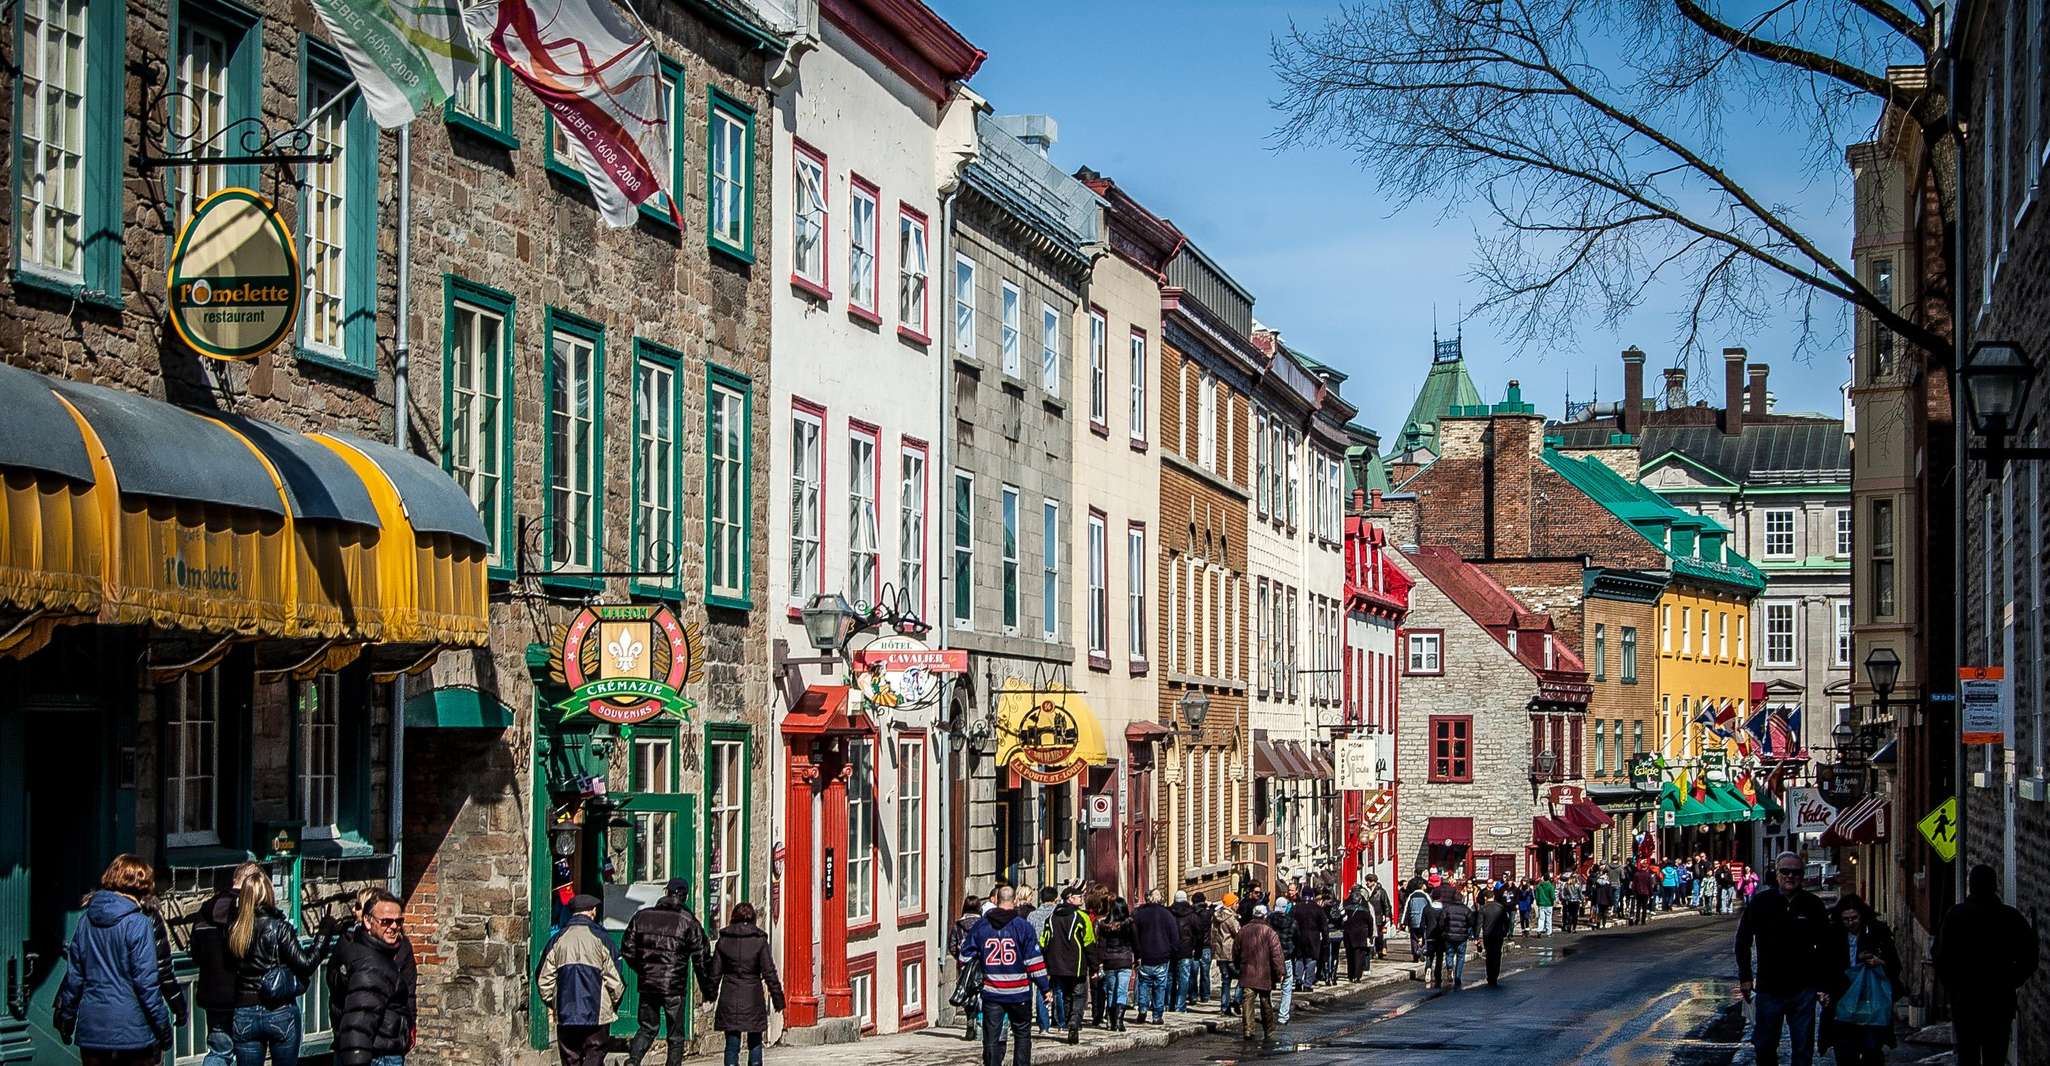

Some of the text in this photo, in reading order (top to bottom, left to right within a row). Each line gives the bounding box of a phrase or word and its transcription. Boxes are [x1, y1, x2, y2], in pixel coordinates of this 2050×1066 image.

[554, 103, 597, 140] QUÉBEC
[204, 310, 265, 323] restaurant
[601, 607, 648, 619] MAISON
[881, 640, 912, 650] HÔTEL
[888, 653, 943, 664] CAVALIER
[587, 680, 663, 696] CRÉMAZIE
[599, 705, 653, 719] SOUVENIRS
[1014, 761, 1023, 771] LA
[1024, 768, 1049, 783] PORTE
[985, 938, 1017, 966] 26
